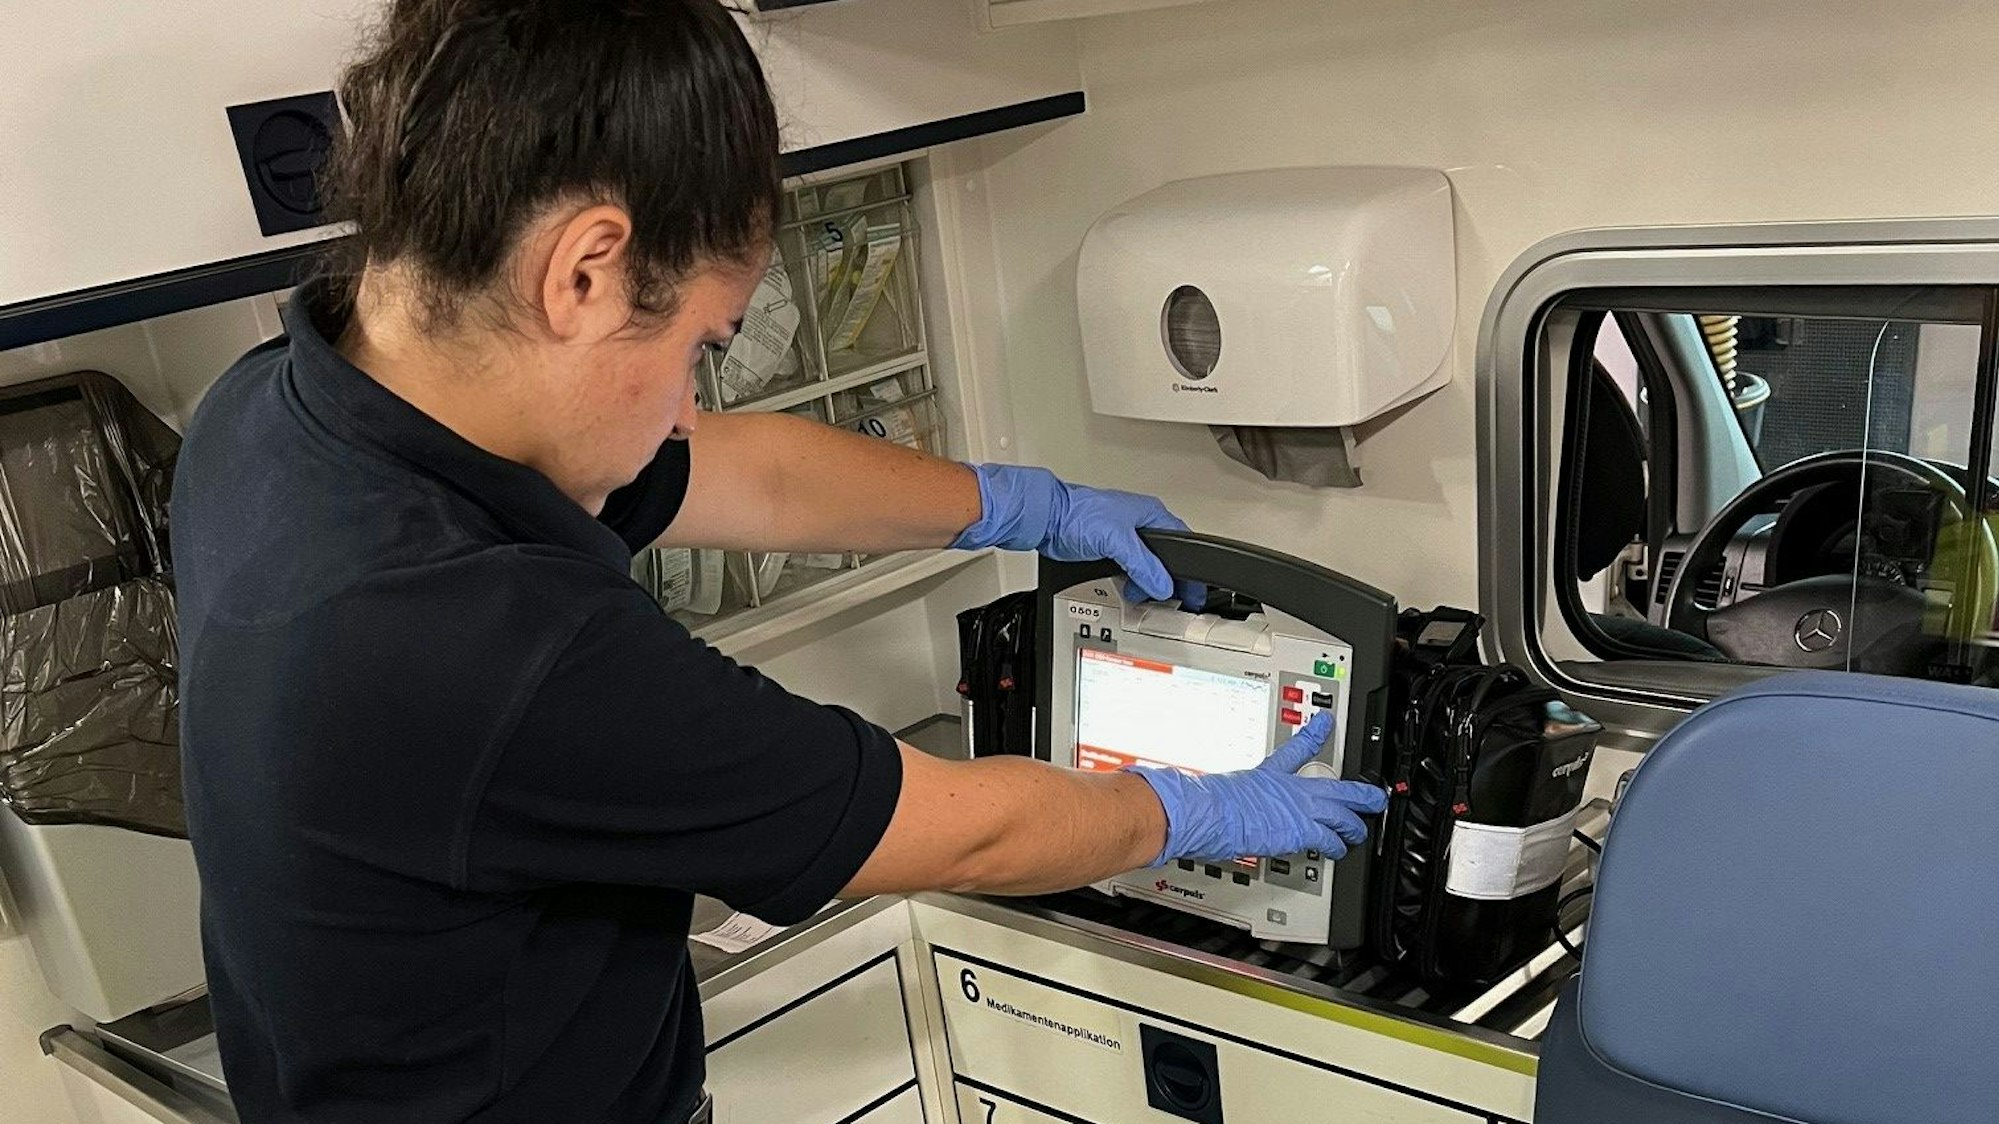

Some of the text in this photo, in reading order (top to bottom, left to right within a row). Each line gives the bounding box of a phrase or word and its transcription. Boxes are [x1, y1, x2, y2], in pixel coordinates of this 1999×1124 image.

[825, 222, 843, 242] 5
[960, 968, 980, 1003] 6
[987, 998, 1121, 1050] Medikamentenapplikation
[979, 1097, 996, 1124] 7
